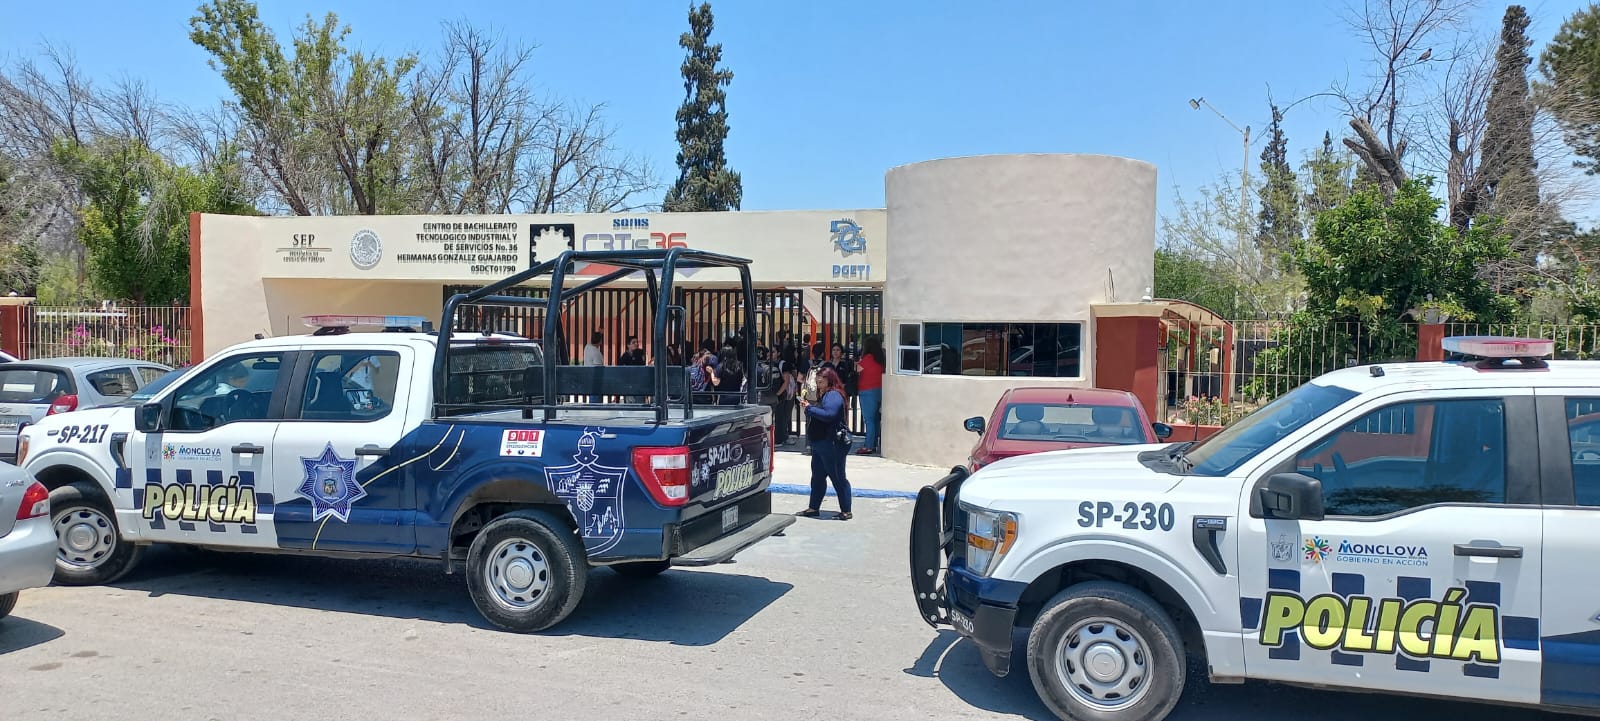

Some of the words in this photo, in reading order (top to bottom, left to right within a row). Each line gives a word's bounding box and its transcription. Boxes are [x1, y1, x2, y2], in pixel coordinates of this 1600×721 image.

[423, 222, 451, 230] CENTRO
[453, 222, 463, 230] DE
[463, 222, 518, 230] BACHILLERATO
[292, 233, 315, 246] SEP
[416, 233, 467, 241] TECNOLOGICO
[468, 233, 510, 241] INDUSTRIAL
[511, 233, 518, 241] Y
[444, 243, 454, 251] DE
[456, 243, 494, 251] SERVICIOS
[508, 243, 518, 251] 36
[397, 253, 437, 261] HERMANAS
[437, 253, 476, 261] GONZALEZ
[477, 253, 518, 261] GUAJARDO
[57, 424, 109, 444] SP-217
[509, 431, 538, 441] 911
[178, 445, 222, 455] MONCLOVA
[708, 443, 731, 467] SP-217
[712, 453, 755, 501] POLICÍA
[142, 475, 256, 524] POLICÍA
[1077, 500, 1175, 532] SP-230
[1338, 539, 1428, 557] MONCLOVA
[1336, 556, 1380, 564] GOBIERNO
[1396, 559, 1429, 567] ACCIÓN
[951, 609, 974, 633] SP-230
[1259, 588, 1501, 663] POLICÍA
